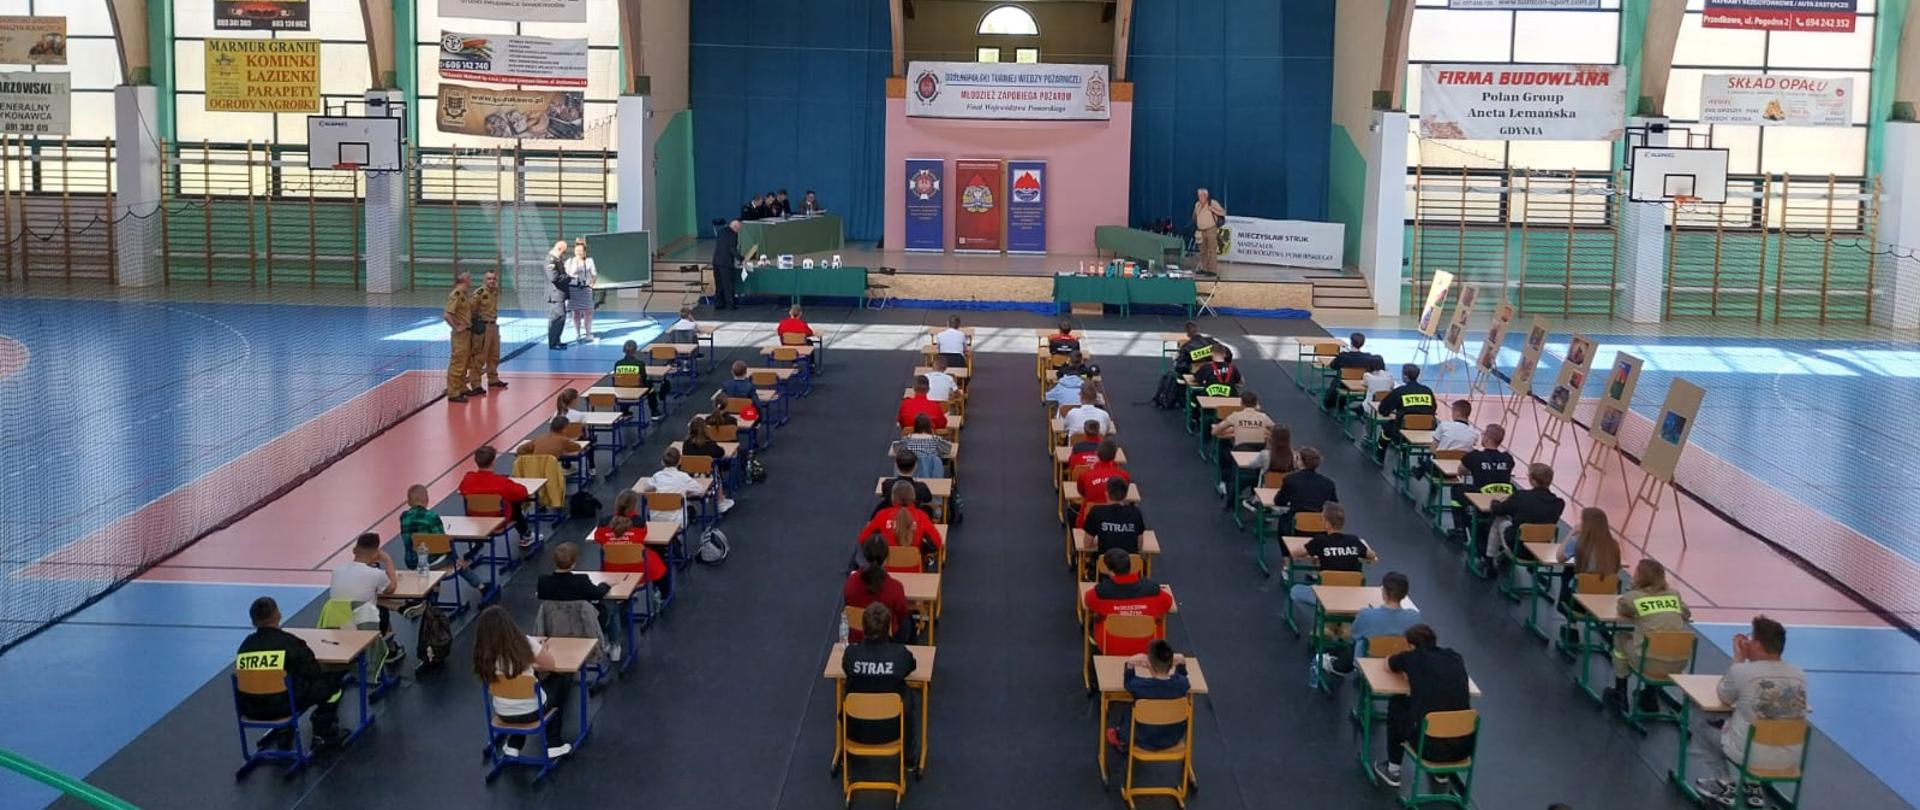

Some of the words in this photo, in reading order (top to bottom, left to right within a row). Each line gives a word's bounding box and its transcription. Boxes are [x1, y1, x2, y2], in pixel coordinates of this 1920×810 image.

[209, 41, 265, 52] MARMUR
[269, 41, 317, 53] GRANIT
[246, 54, 316, 68] KOMINKI
[247, 70, 316, 83] ŁAZIENKI
[1438, 71, 1493, 85] FIRMA
[1499, 71, 1610, 87] BUDOWLANA
[1728, 76, 1776, 89] SKŁAD
[1780, 78, 1829, 92] OPAŁU
[247, 86, 315, 97] PARAPETY
[209, 99, 257, 109] OGRODY
[259, 100, 316, 110] NAGROBKI
[1482, 92, 1519, 102] Polan
[1523, 92, 1564, 105] Group
[1467, 108, 1505, 118] Aneta
[1509, 107, 1576, 119] Lemańska
[1499, 126, 1543, 136] GDYNIA
